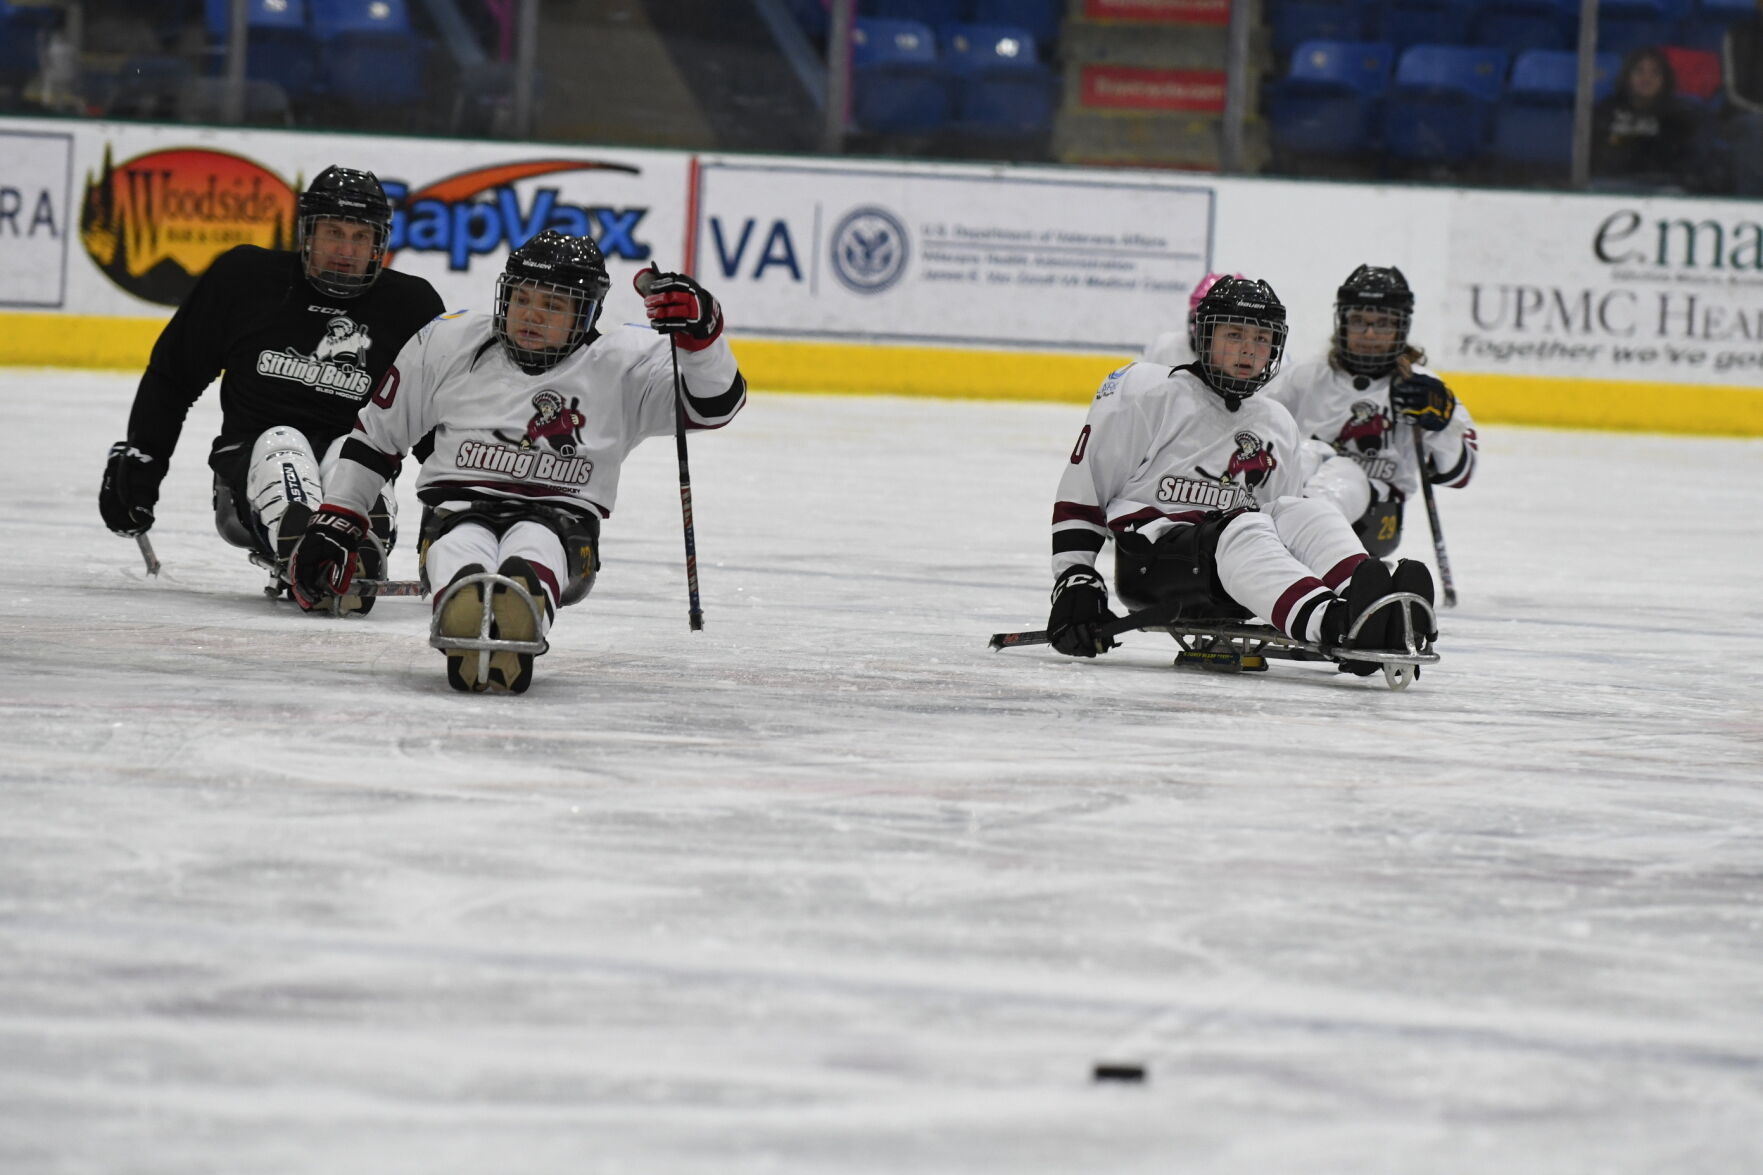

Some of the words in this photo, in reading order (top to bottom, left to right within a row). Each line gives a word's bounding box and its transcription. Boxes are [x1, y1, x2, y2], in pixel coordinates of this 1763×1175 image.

[126, 169, 277, 257] Woodside
[709, 216, 803, 282] VA
[307, 304, 348, 316] CCM
[1468, 284, 1640, 339] UPMC
[1458, 334, 1603, 364] Together
[257, 350, 322, 385] Sitting
[320, 363, 370, 395] Bulls
[281, 462, 303, 502] ASTON
[457, 440, 534, 480] Sitting
[533, 452, 594, 485] Bulls
[1157, 475, 1236, 511] Sitting
